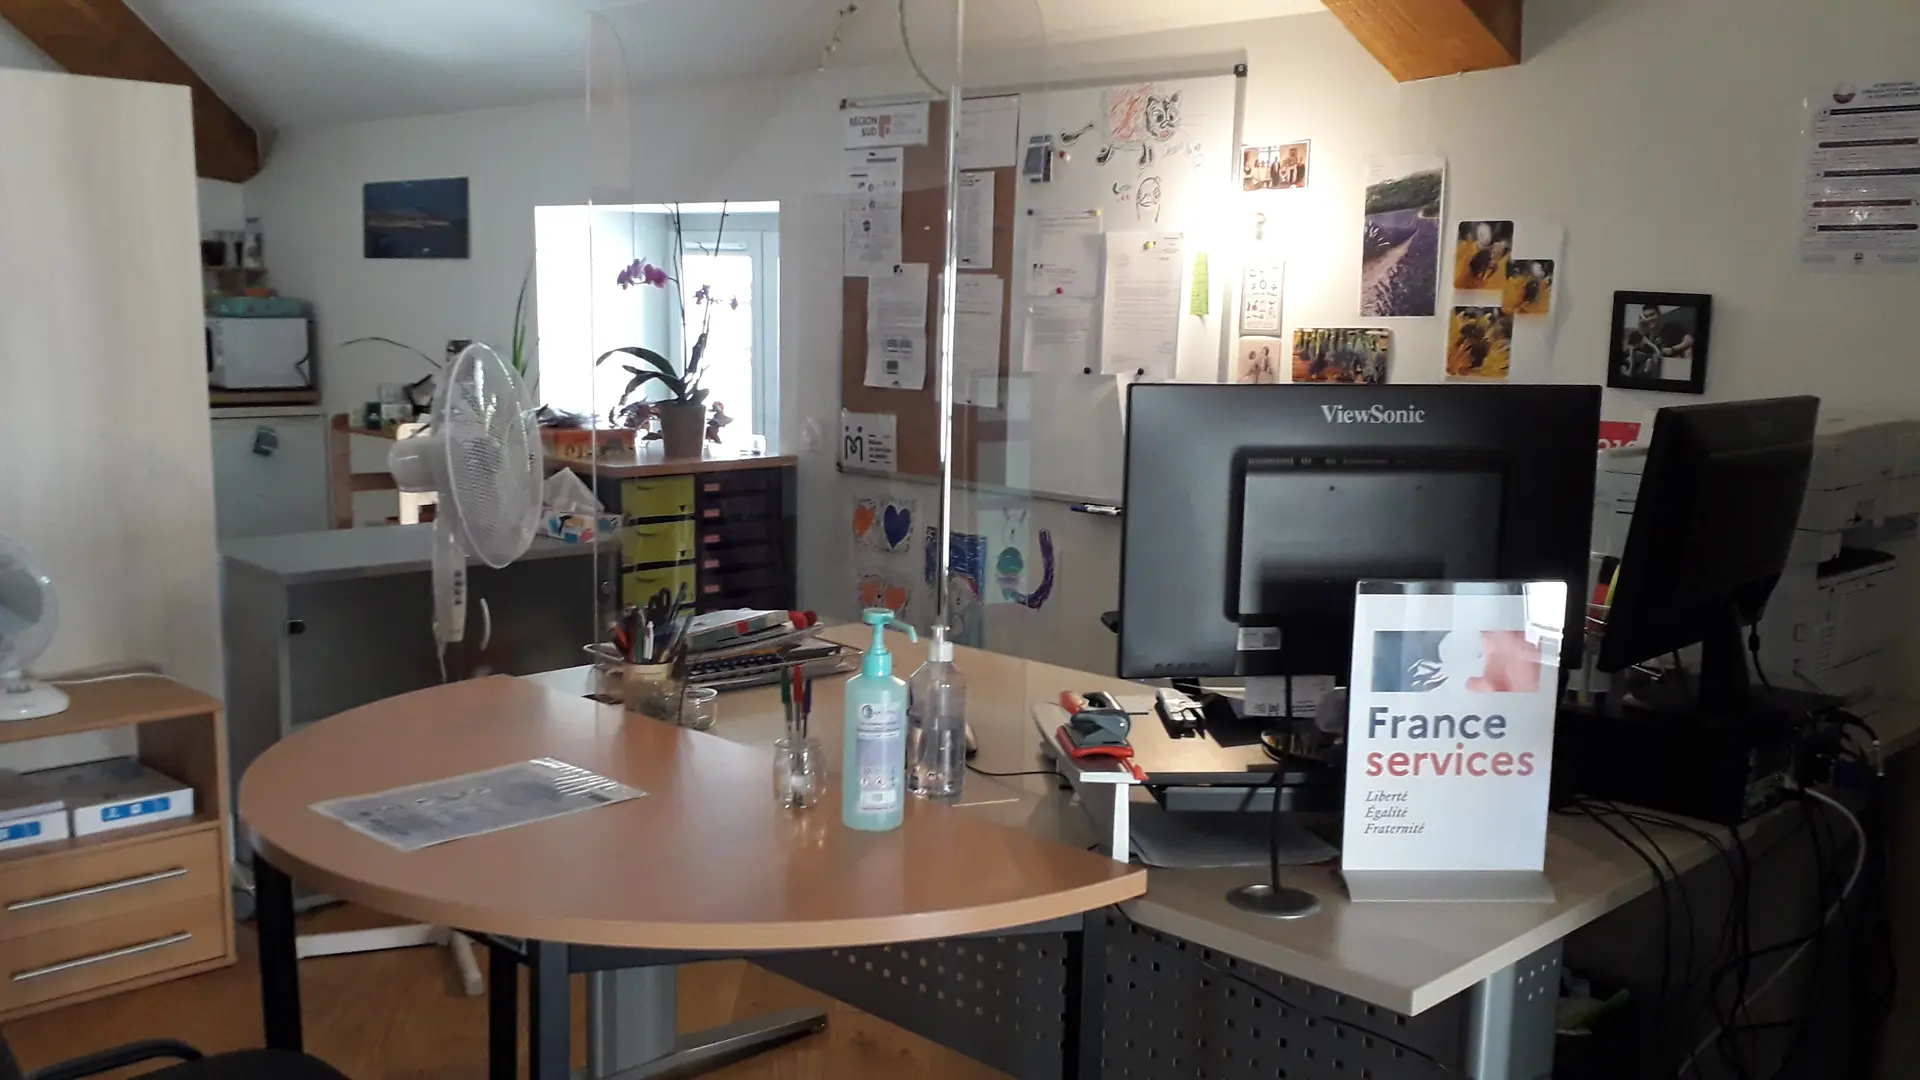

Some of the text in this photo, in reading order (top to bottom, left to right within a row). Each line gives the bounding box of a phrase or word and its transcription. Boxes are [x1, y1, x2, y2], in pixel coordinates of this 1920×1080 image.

[861, 126, 877, 137] SUD
[1320, 404, 1426, 424] ViewSonic
[1367, 706, 1507, 740] France
[1365, 742, 1535, 777] services
[1365, 790, 1408, 803] Liberté
[1364, 805, 1408, 820] Égalité
[1364, 823, 1425, 835] Fraternité
